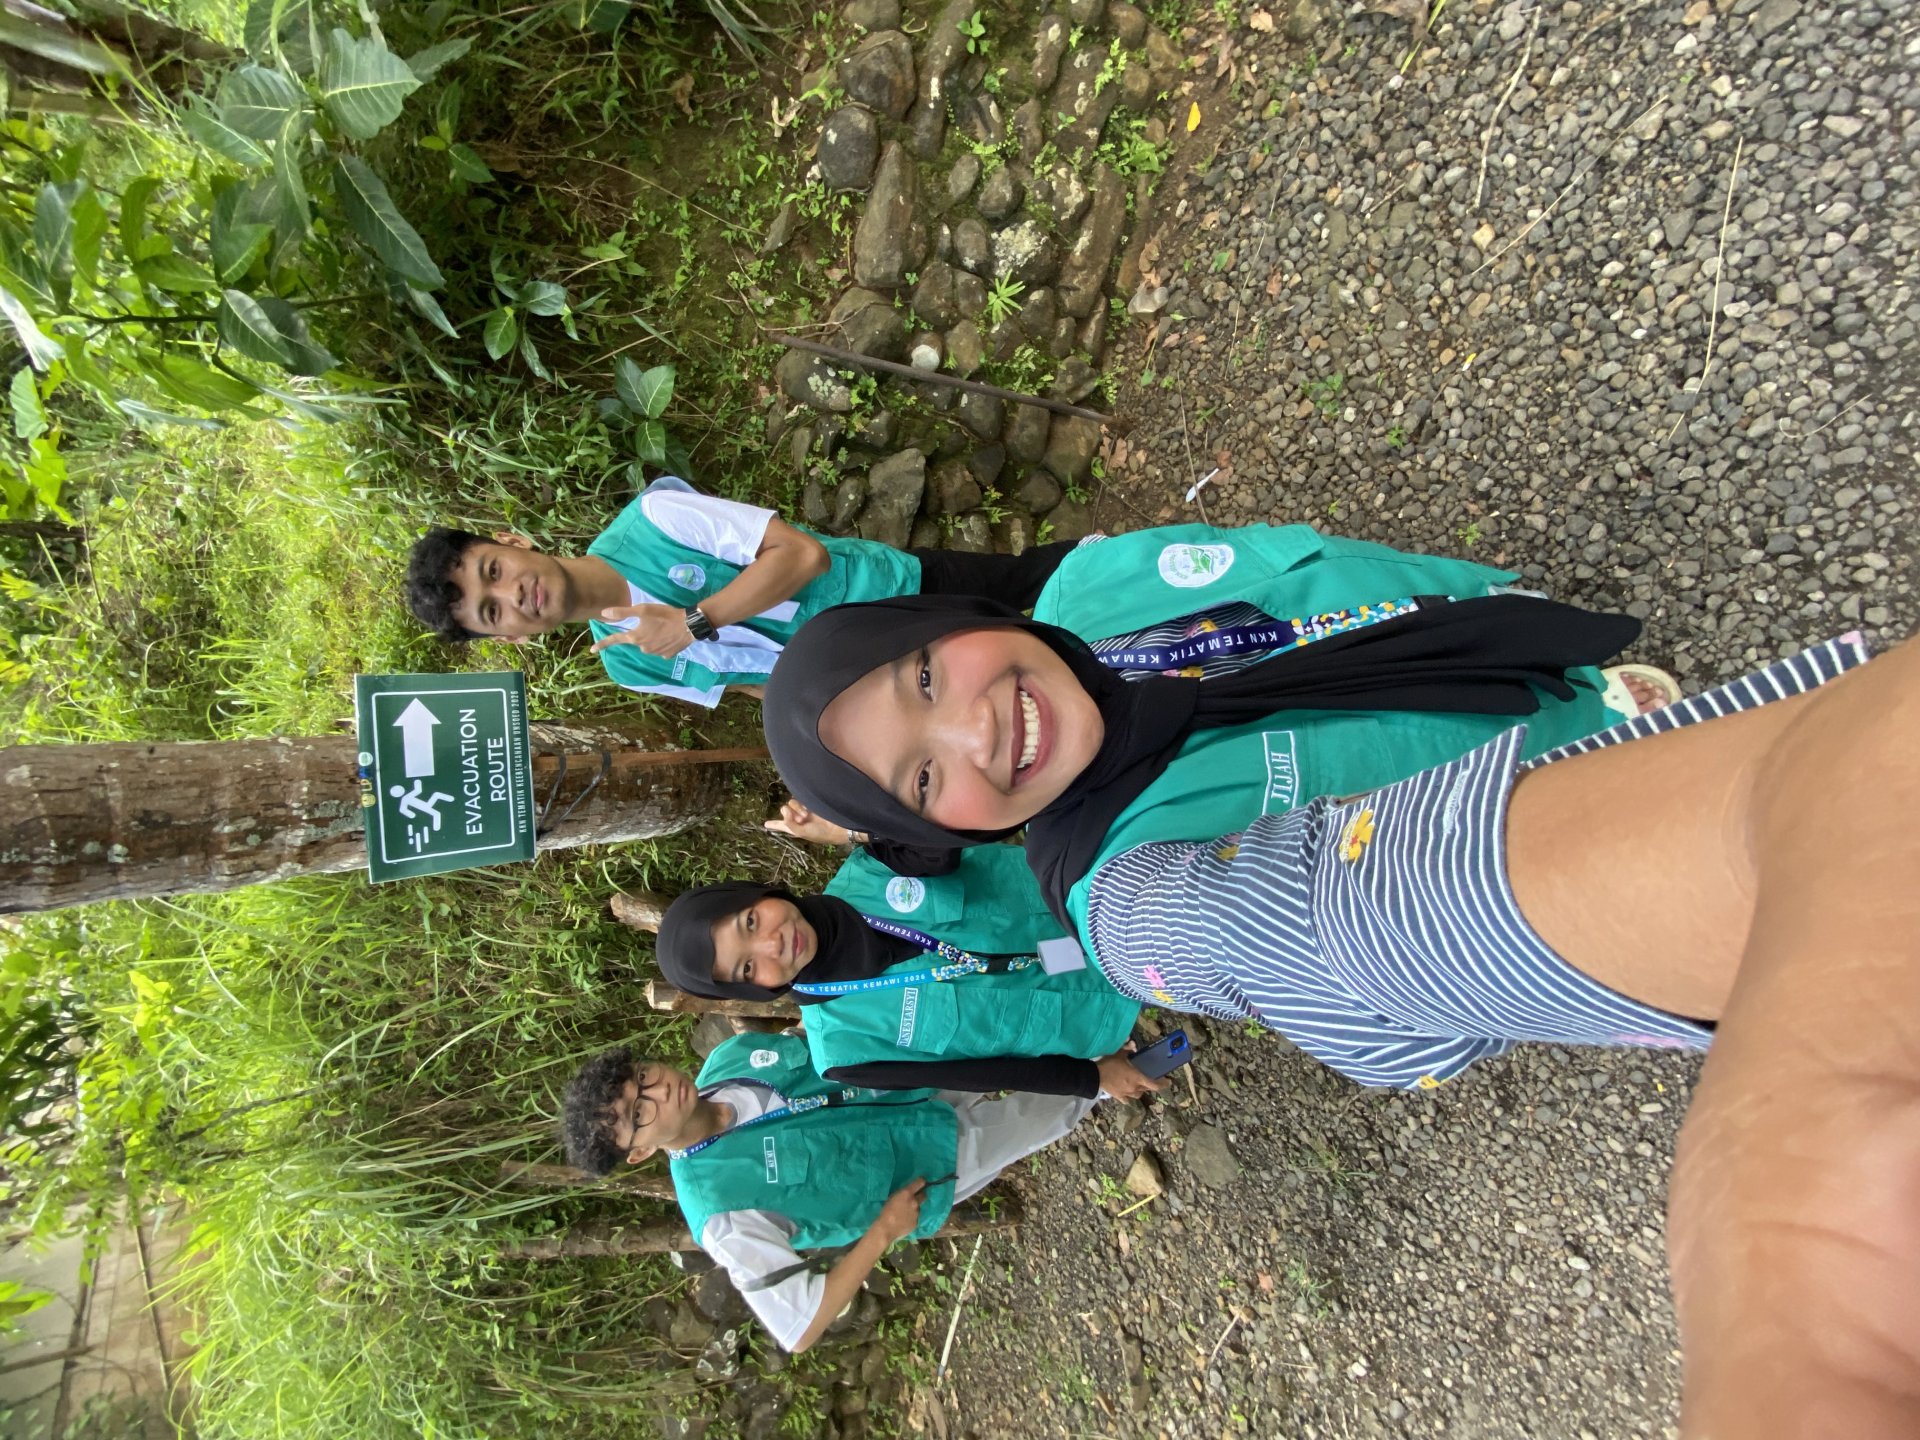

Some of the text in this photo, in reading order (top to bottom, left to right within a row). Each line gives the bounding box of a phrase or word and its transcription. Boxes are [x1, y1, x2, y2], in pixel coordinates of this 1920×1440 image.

[1168, 633, 1244, 662] TEMATIK
[1249, 630, 1278, 643] KKN
[510, 690, 519, 707] 2026
[512, 709, 521, 735] UNSOED
[459, 708, 483, 835] EVACUATION
[487, 737, 507, 801] ROUTE
[1270, 751, 1293, 804] JIJAH
[517, 789, 526, 818] TEMATIK
[519, 820, 527, 833] KKN
[874, 920, 911, 937] TEMATIK
[914, 933, 932, 946] KKN
[818, 984, 859, 992] TEMATIK
[863, 978, 900, 989] KEMAWI
[904, 973, 926, 983] 2026
